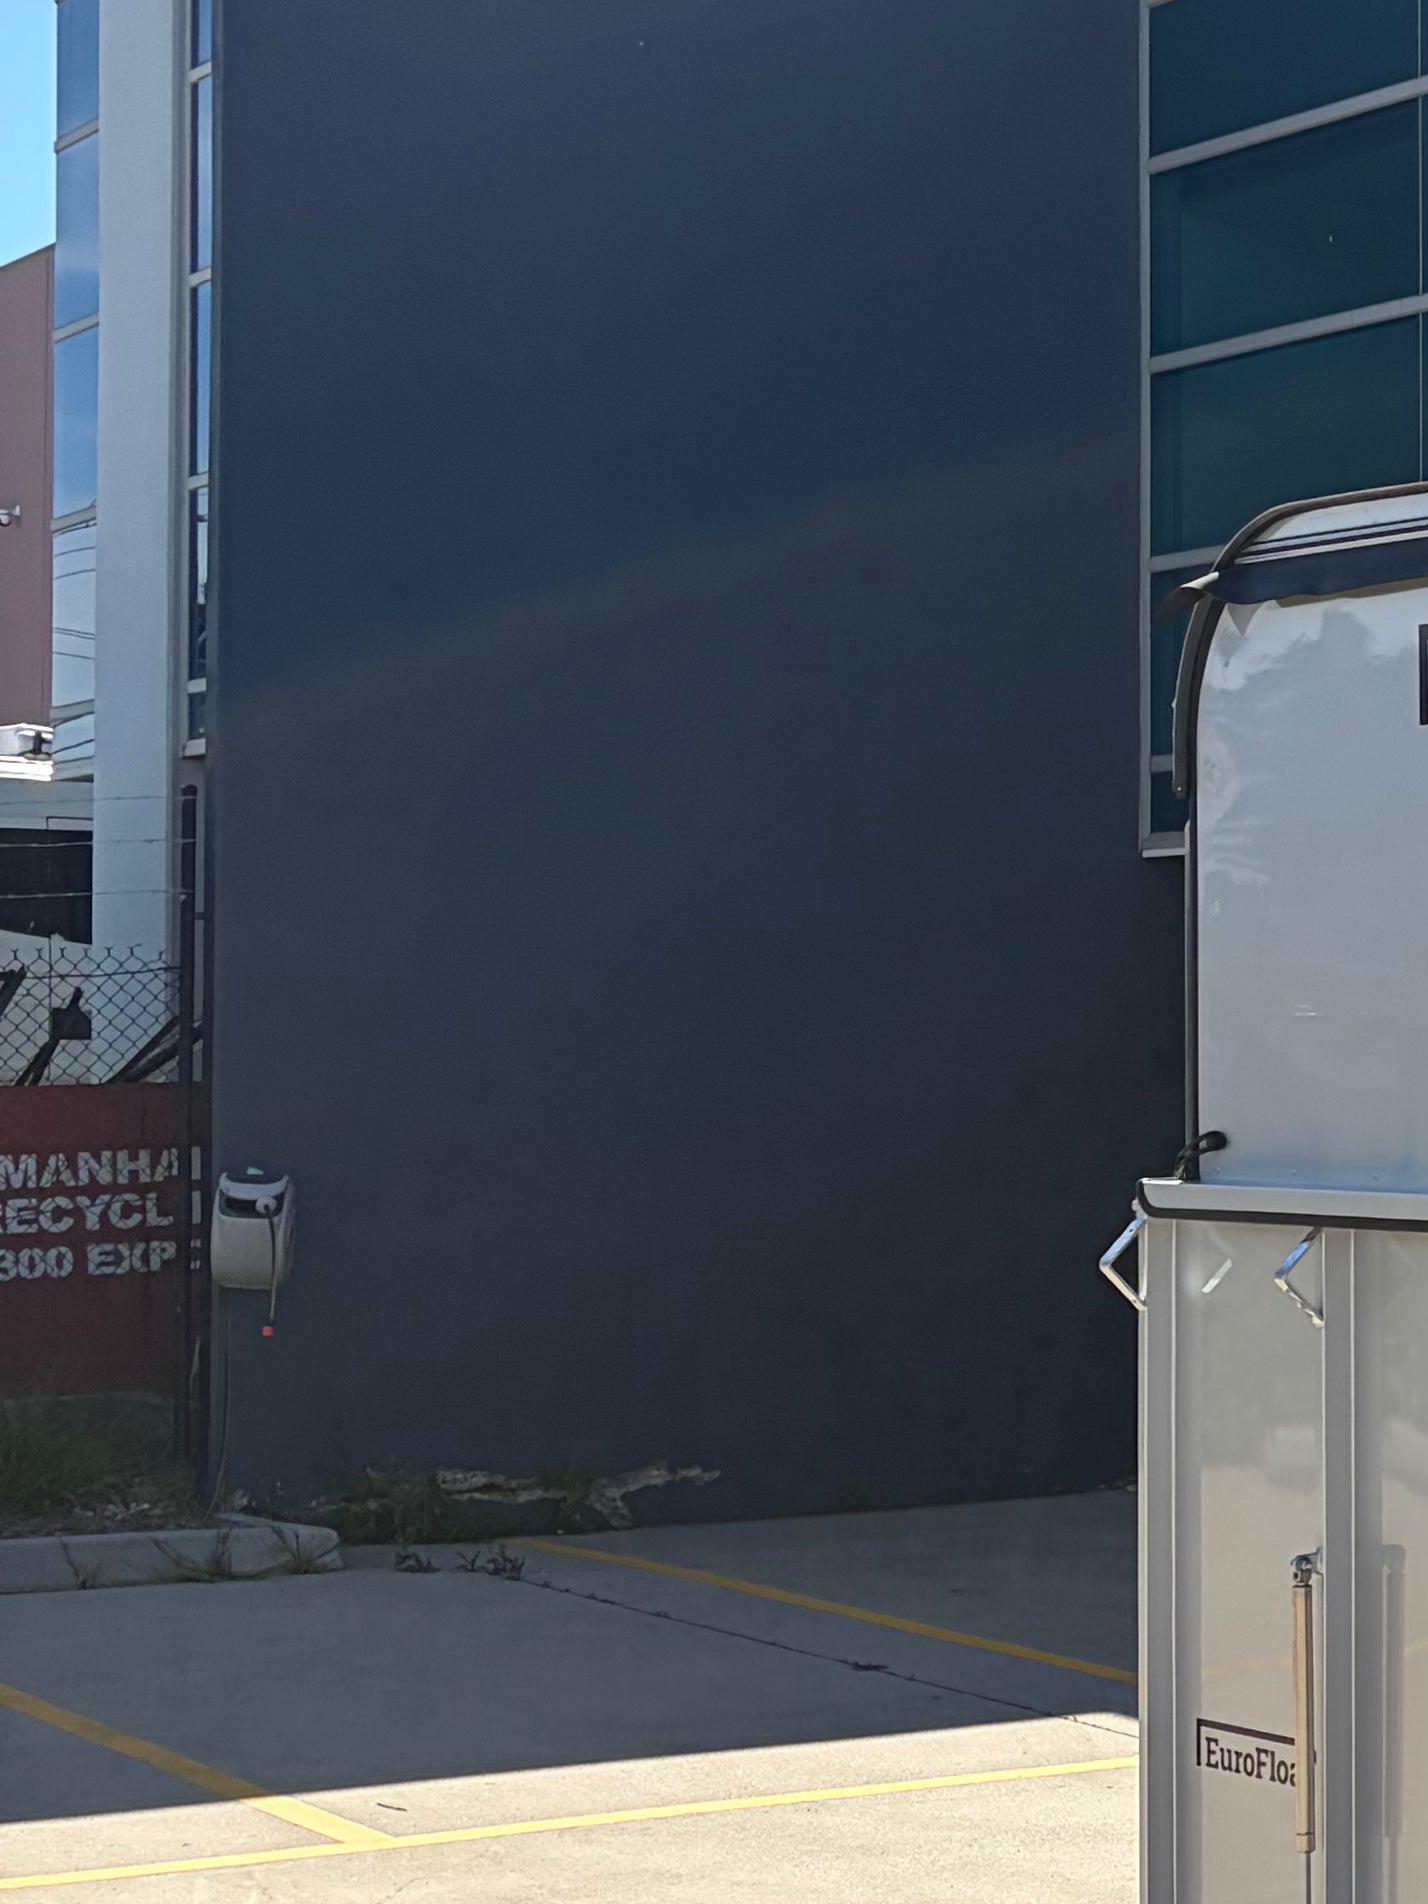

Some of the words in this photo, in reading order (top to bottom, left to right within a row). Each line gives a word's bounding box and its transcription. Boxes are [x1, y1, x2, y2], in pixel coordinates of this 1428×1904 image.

[0, 1146, 201, 1191] MANHA
[0, 1190, 201, 1235] ECYCL
[1204, 1736, 1296, 1787] EuroFlo
